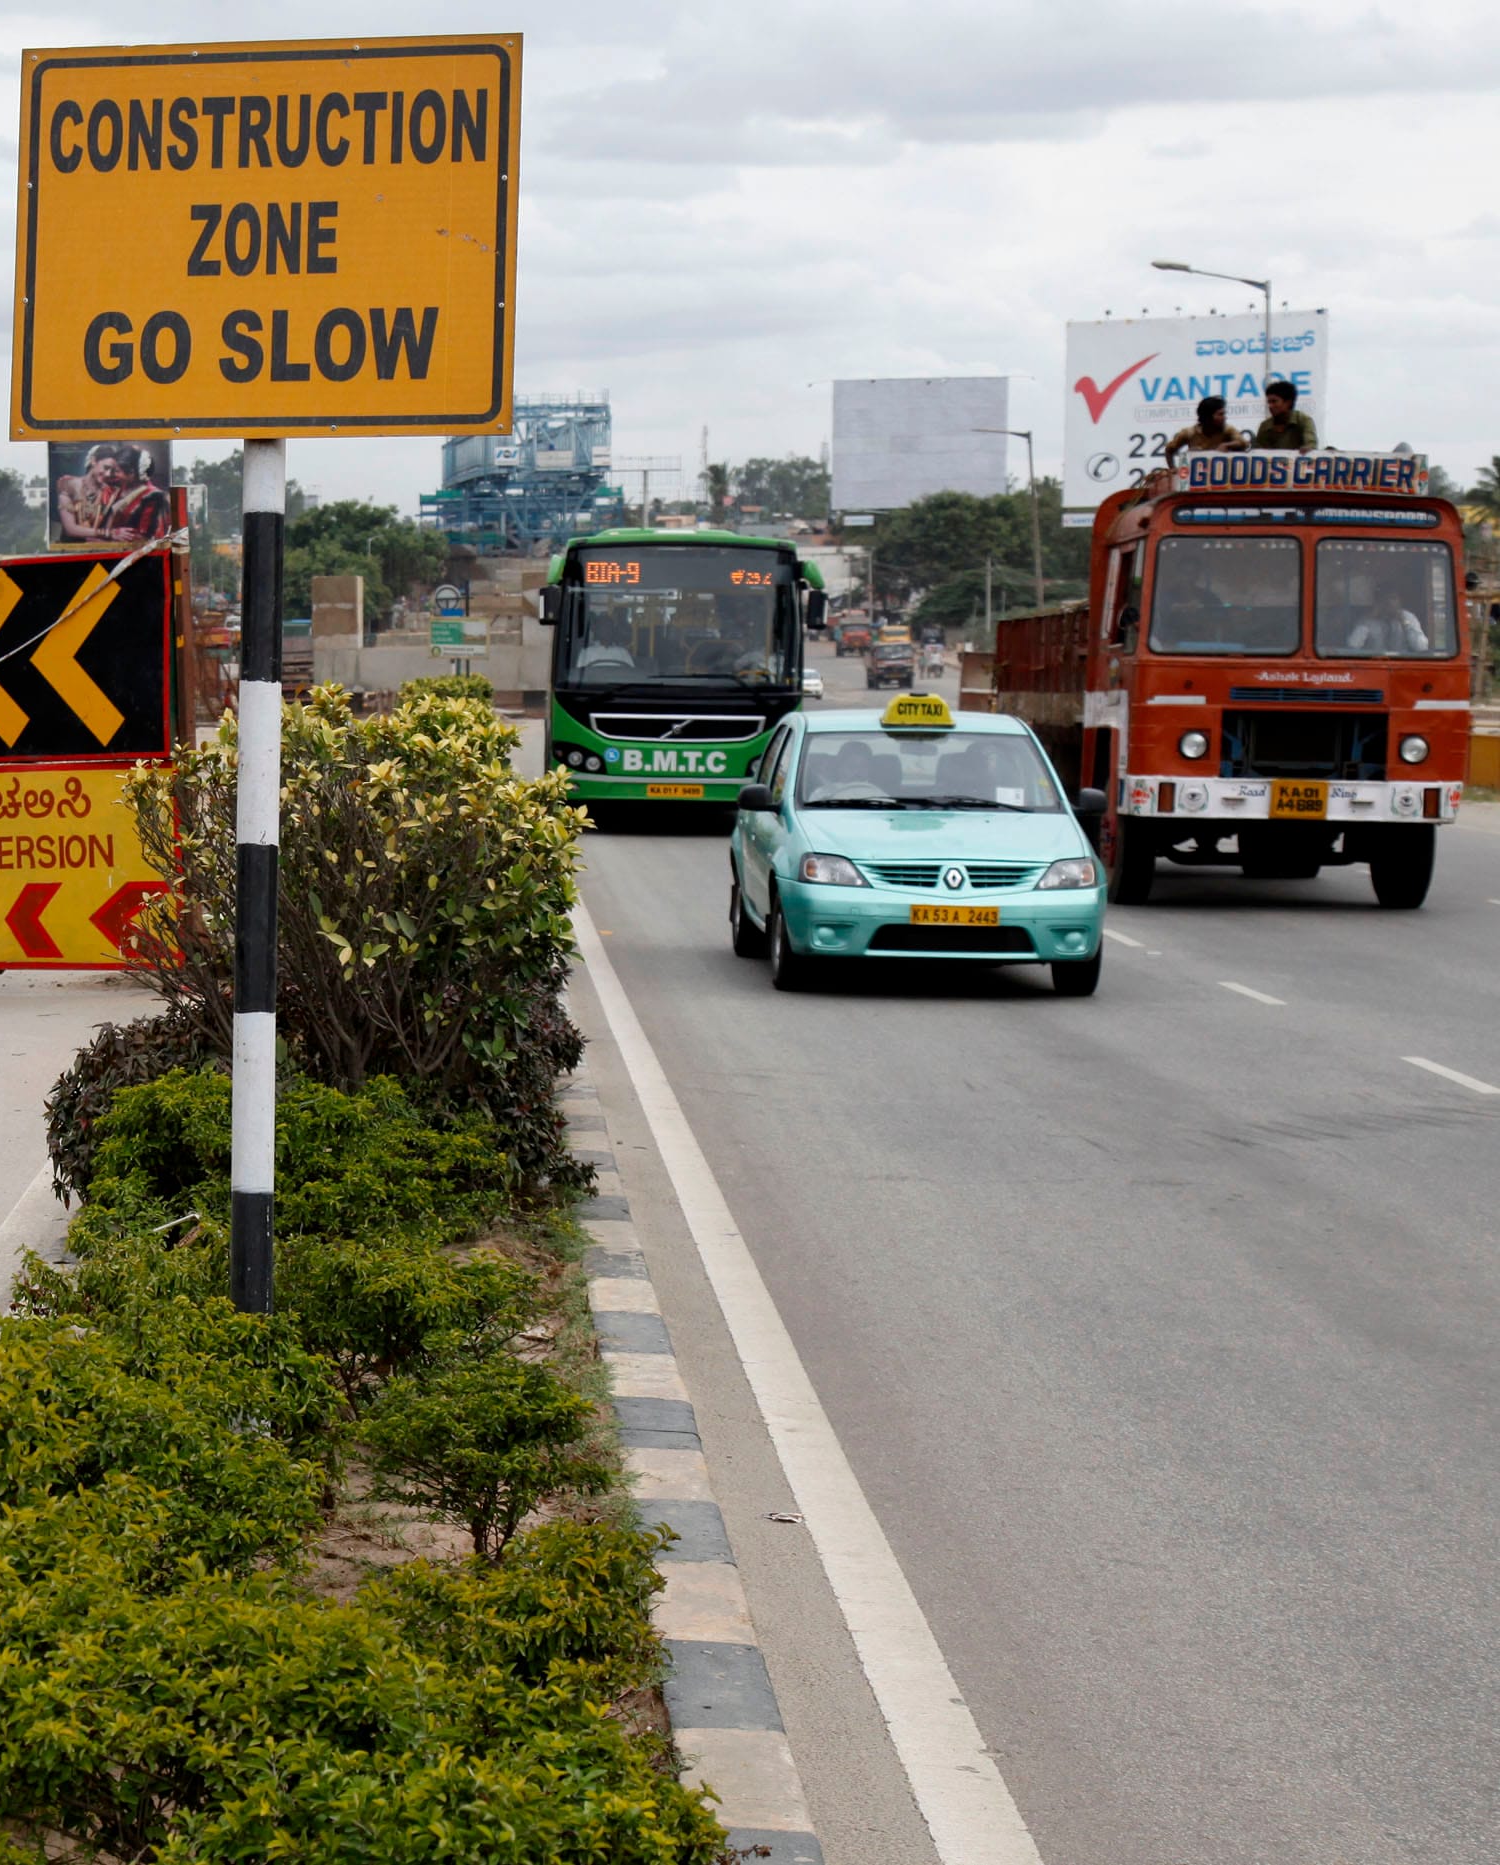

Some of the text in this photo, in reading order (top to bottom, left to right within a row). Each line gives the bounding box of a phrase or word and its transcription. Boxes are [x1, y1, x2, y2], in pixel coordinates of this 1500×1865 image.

[50, 88, 488, 174] CONSTRUCTION
[187, 201, 339, 278] ZONE
[83, 306, 439, 386] GO SLOW
[1190, 455, 1289, 489] GOODS
[1292, 456, 1416, 493] CARRIER
[586, 561, 641, 584] BIA-9
[897, 703, 943, 716] CITY TAXI
[623, 749, 727, 774] B.M.T.C
[912, 908, 998, 924] KA 53 A 2443
